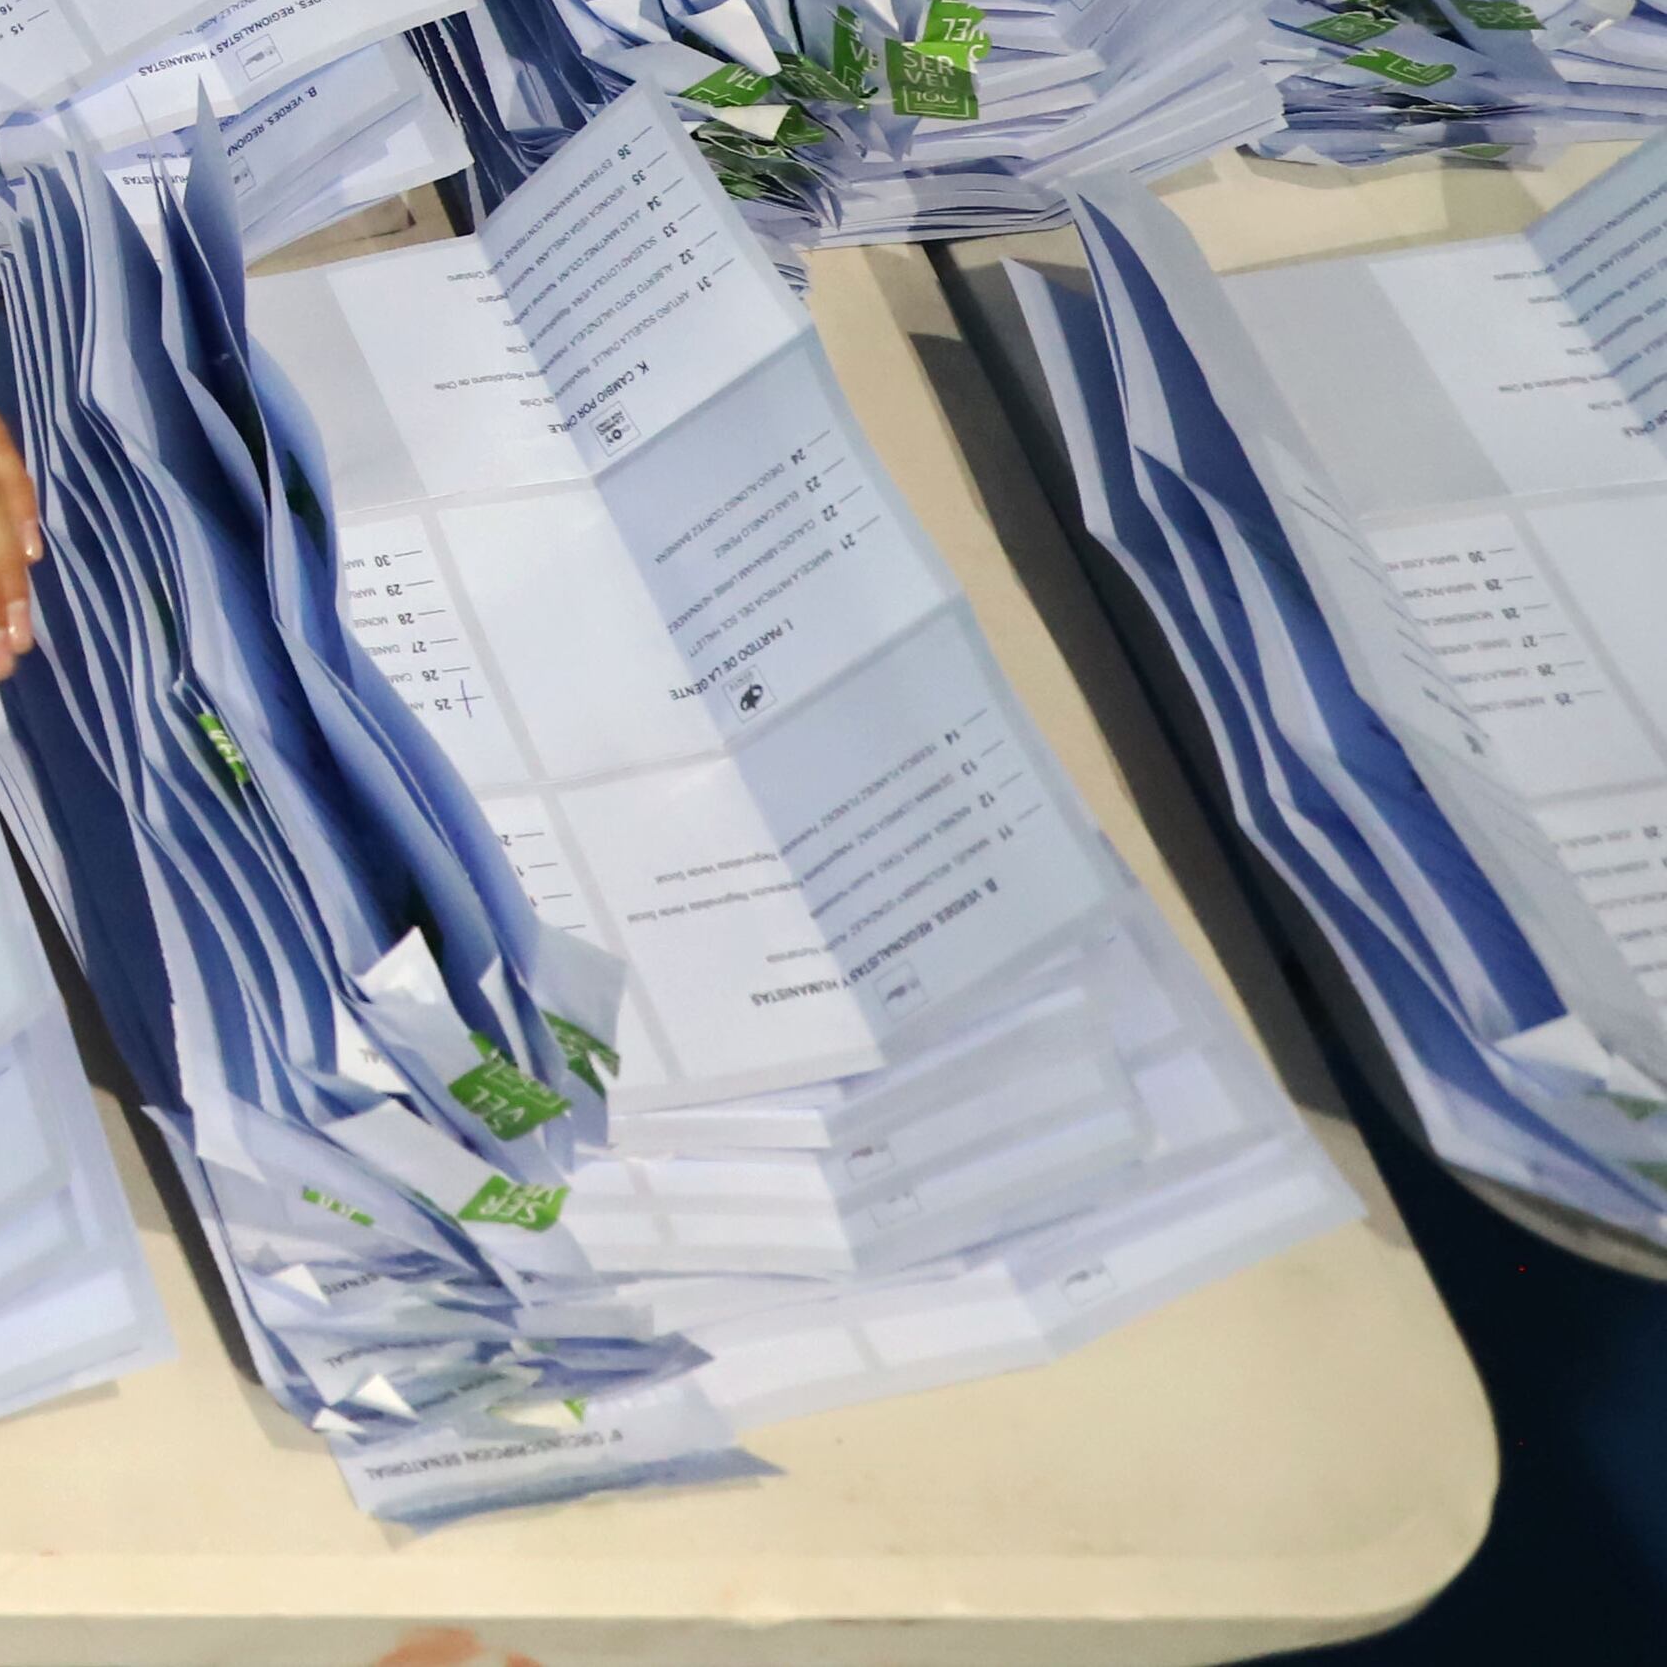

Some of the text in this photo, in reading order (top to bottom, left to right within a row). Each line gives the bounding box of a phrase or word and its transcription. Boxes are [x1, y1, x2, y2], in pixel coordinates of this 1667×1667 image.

[0, 2, 13, 15] 16
[10, 21, 24, 34] 15
[216, 5, 294, 54] REGIONALISTAS
[138, 51, 207, 77] HUMANISTAS
[903, 50, 955, 76] SER
[264, 87, 317, 126] B. VERDES,
[617, 143, 631, 160] 36
[631, 169, 646, 185] 35
[646, 195, 662, 211] 34
[662, 222, 678, 238] 33
[678, 249, 694, 265] 32
[696, 276, 712, 292] 31
[596, 371, 634, 404] CAMBIO
[577, 397, 597, 418] POR
[547, 414, 578, 434] CHILE
[790, 448, 806, 465] 24
[805, 475, 821, 493] 23
[821, 504, 838, 522] 22
[840, 533, 856, 550] 21
[375, 554, 391, 567] 30
[386, 584, 403, 596] 29
[398, 613, 415, 625] 28
[411, 641, 426, 653] 27
[669, 625, 783, 701] PARTIDO DE LA GENTE
[422, 670, 440, 681] 26
[434, 698, 452, 710] 25
[944, 730, 961, 746] 14
[960, 759, 977, 775] 13
[979, 792, 995, 808] 12
[479, 1195, 538, 1223] SER
